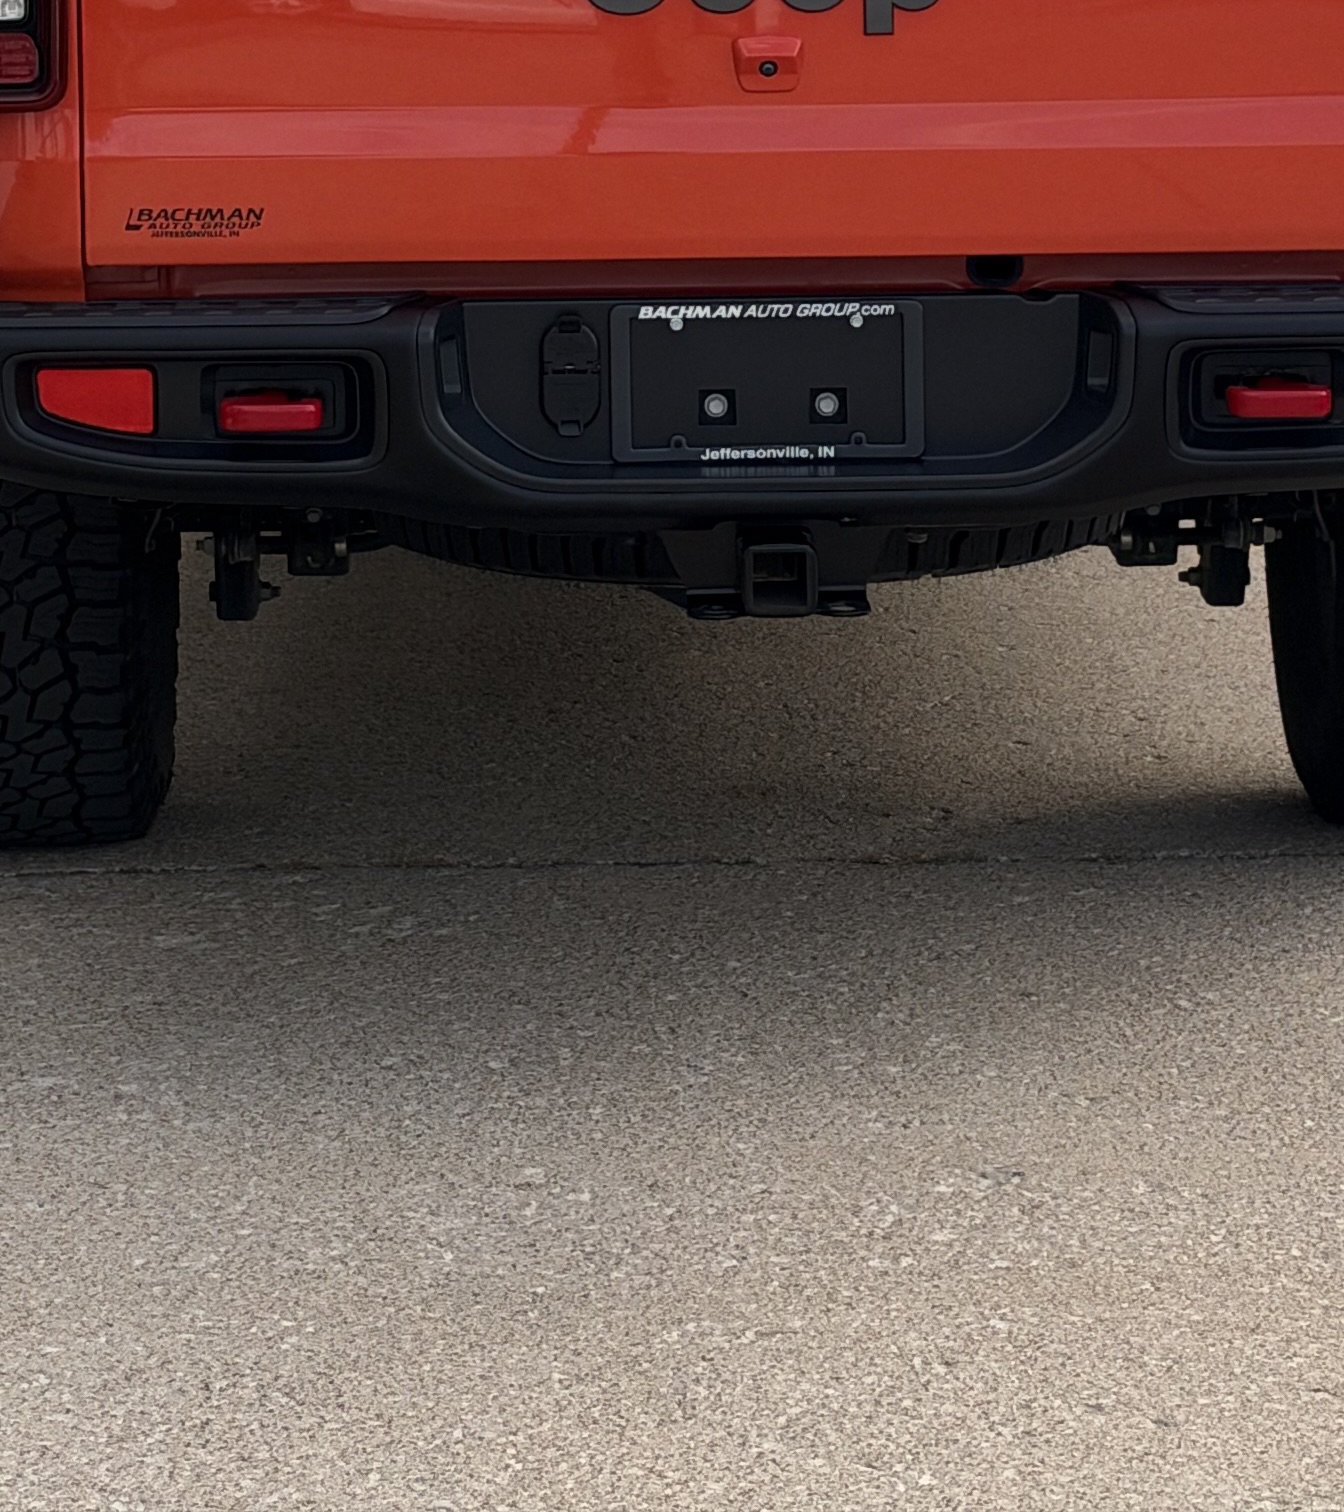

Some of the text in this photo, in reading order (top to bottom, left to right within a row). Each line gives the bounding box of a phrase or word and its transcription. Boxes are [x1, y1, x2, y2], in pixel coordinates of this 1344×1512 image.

[137, 207, 264, 222] BACHMAN
[147, 221, 261, 230] AUTO GROUP
[638, 304, 742, 320] BACHMAN
[743, 304, 793, 318] AUTO
[701, 446, 835, 460] Jeffersonville, IN
